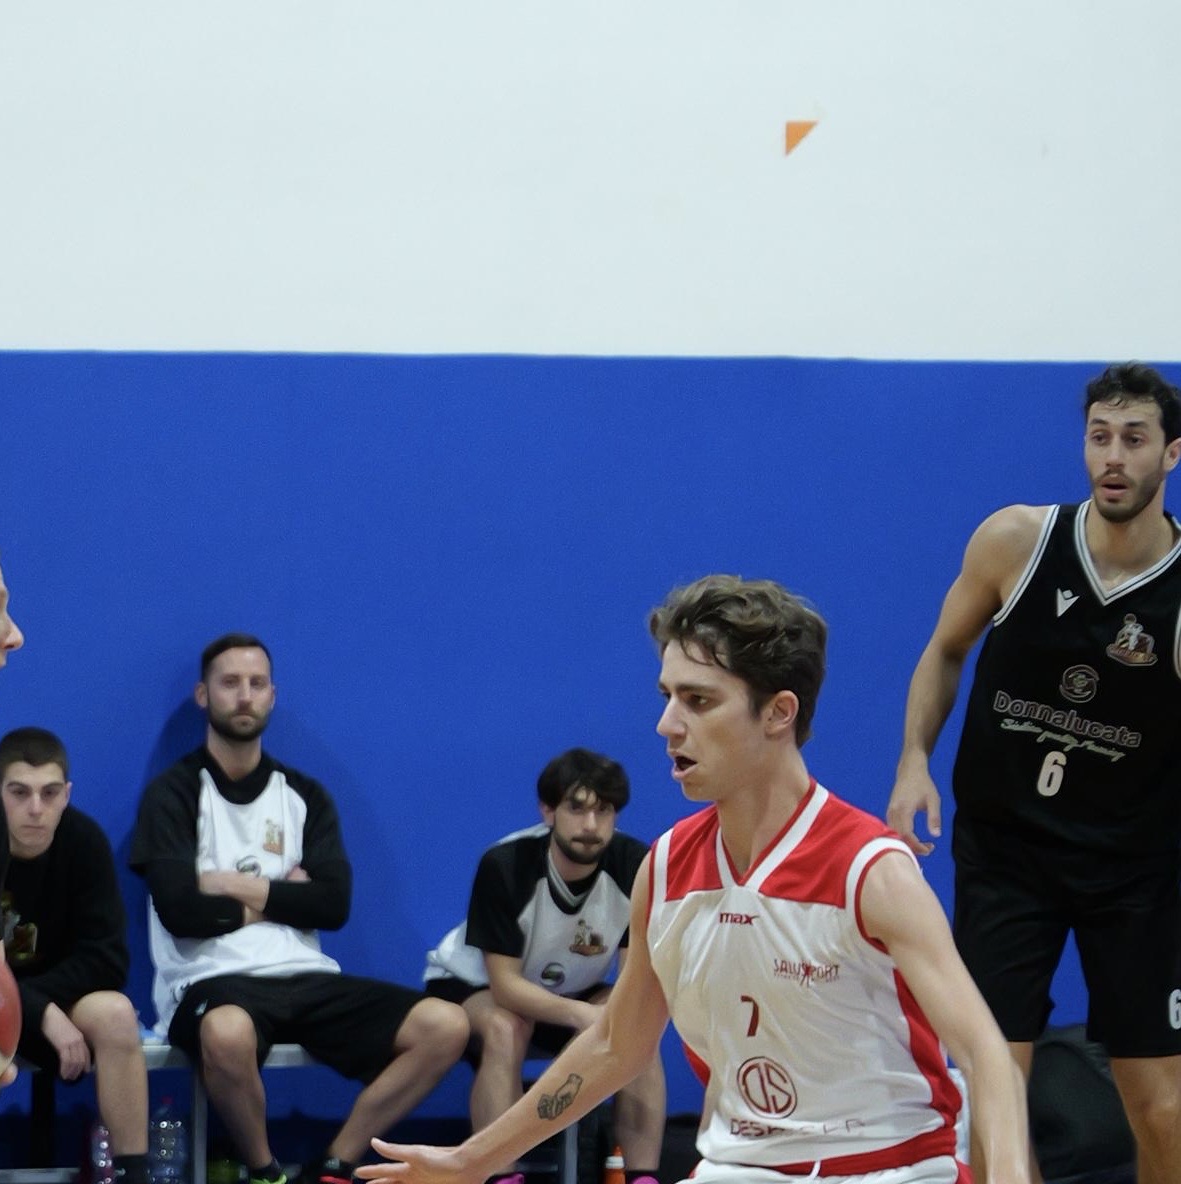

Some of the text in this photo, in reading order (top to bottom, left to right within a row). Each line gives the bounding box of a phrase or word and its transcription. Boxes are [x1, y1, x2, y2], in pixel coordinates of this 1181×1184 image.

[993, 690, 1143, 748] Donnalucata
[1036, 750, 1067, 797] 6
[718, 911, 759, 926] max
[740, 995, 760, 1038] 7
